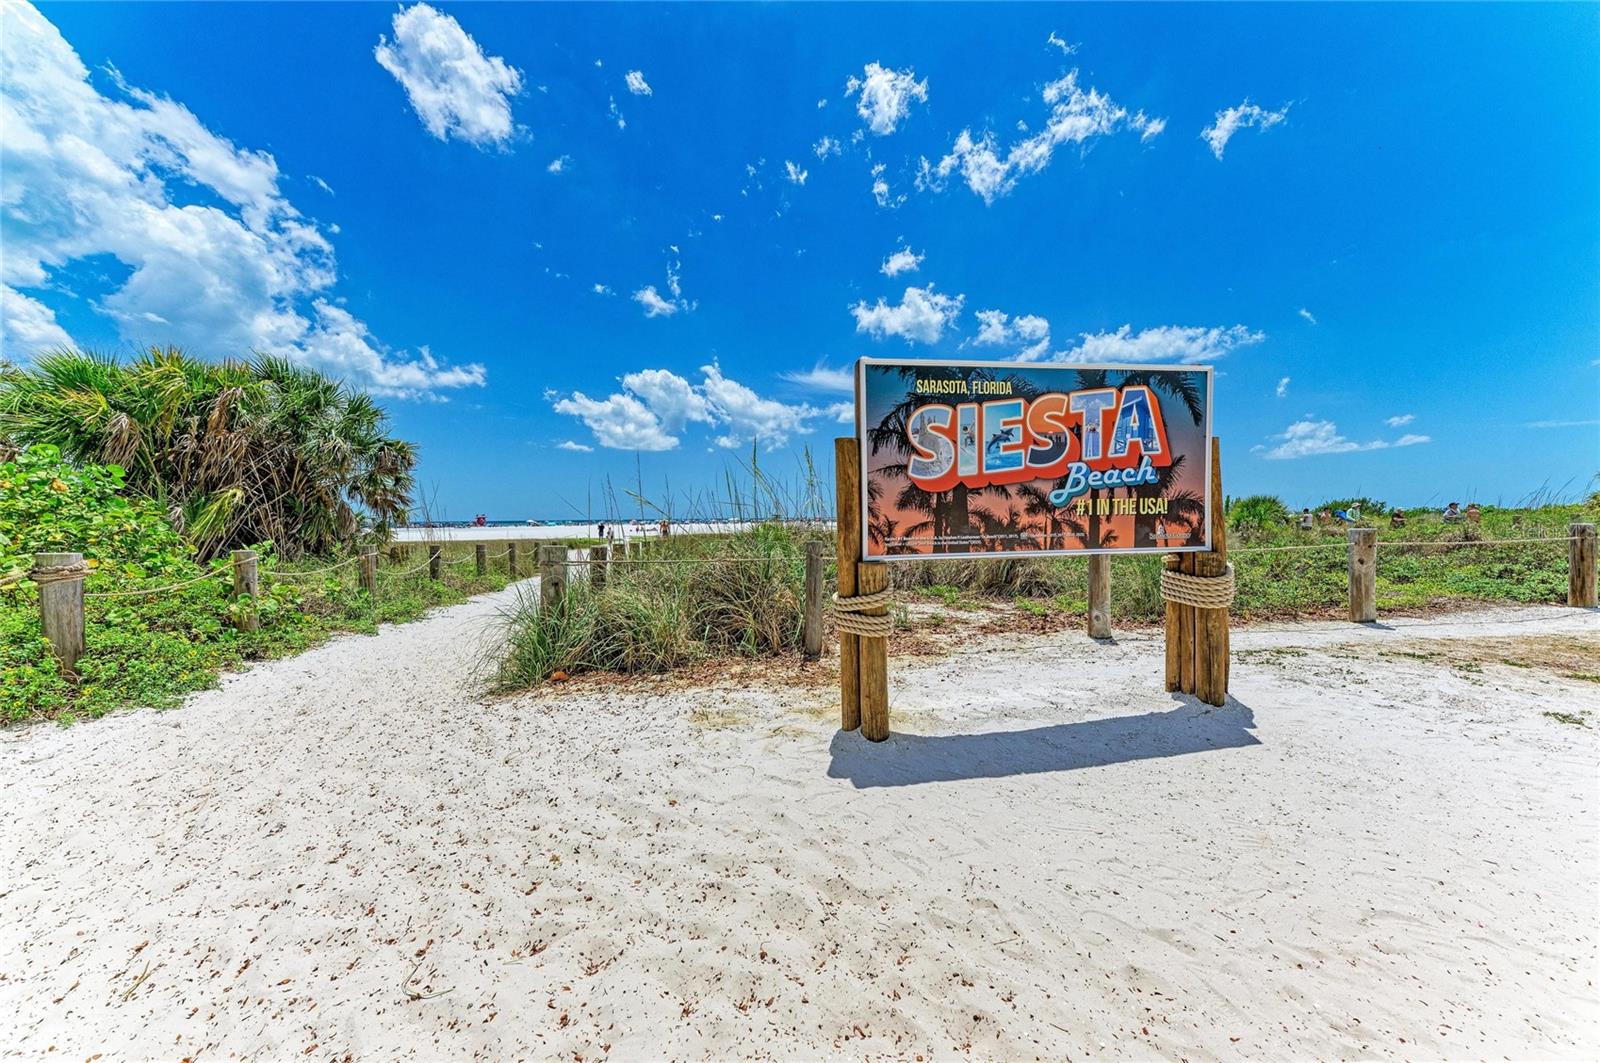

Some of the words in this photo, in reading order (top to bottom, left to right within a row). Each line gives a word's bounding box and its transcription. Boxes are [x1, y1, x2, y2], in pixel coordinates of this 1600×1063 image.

[916, 379, 970, 395] SARASOTA,
[972, 381, 1012, 395] FLORIDA
[907, 385, 1166, 482] SIESTA
[1049, 455, 1158, 505] Beach
[1096, 499, 1110, 515] IN
[1112, 499, 1137, 515] THE
[1140, 498, 1168, 515] USA!
